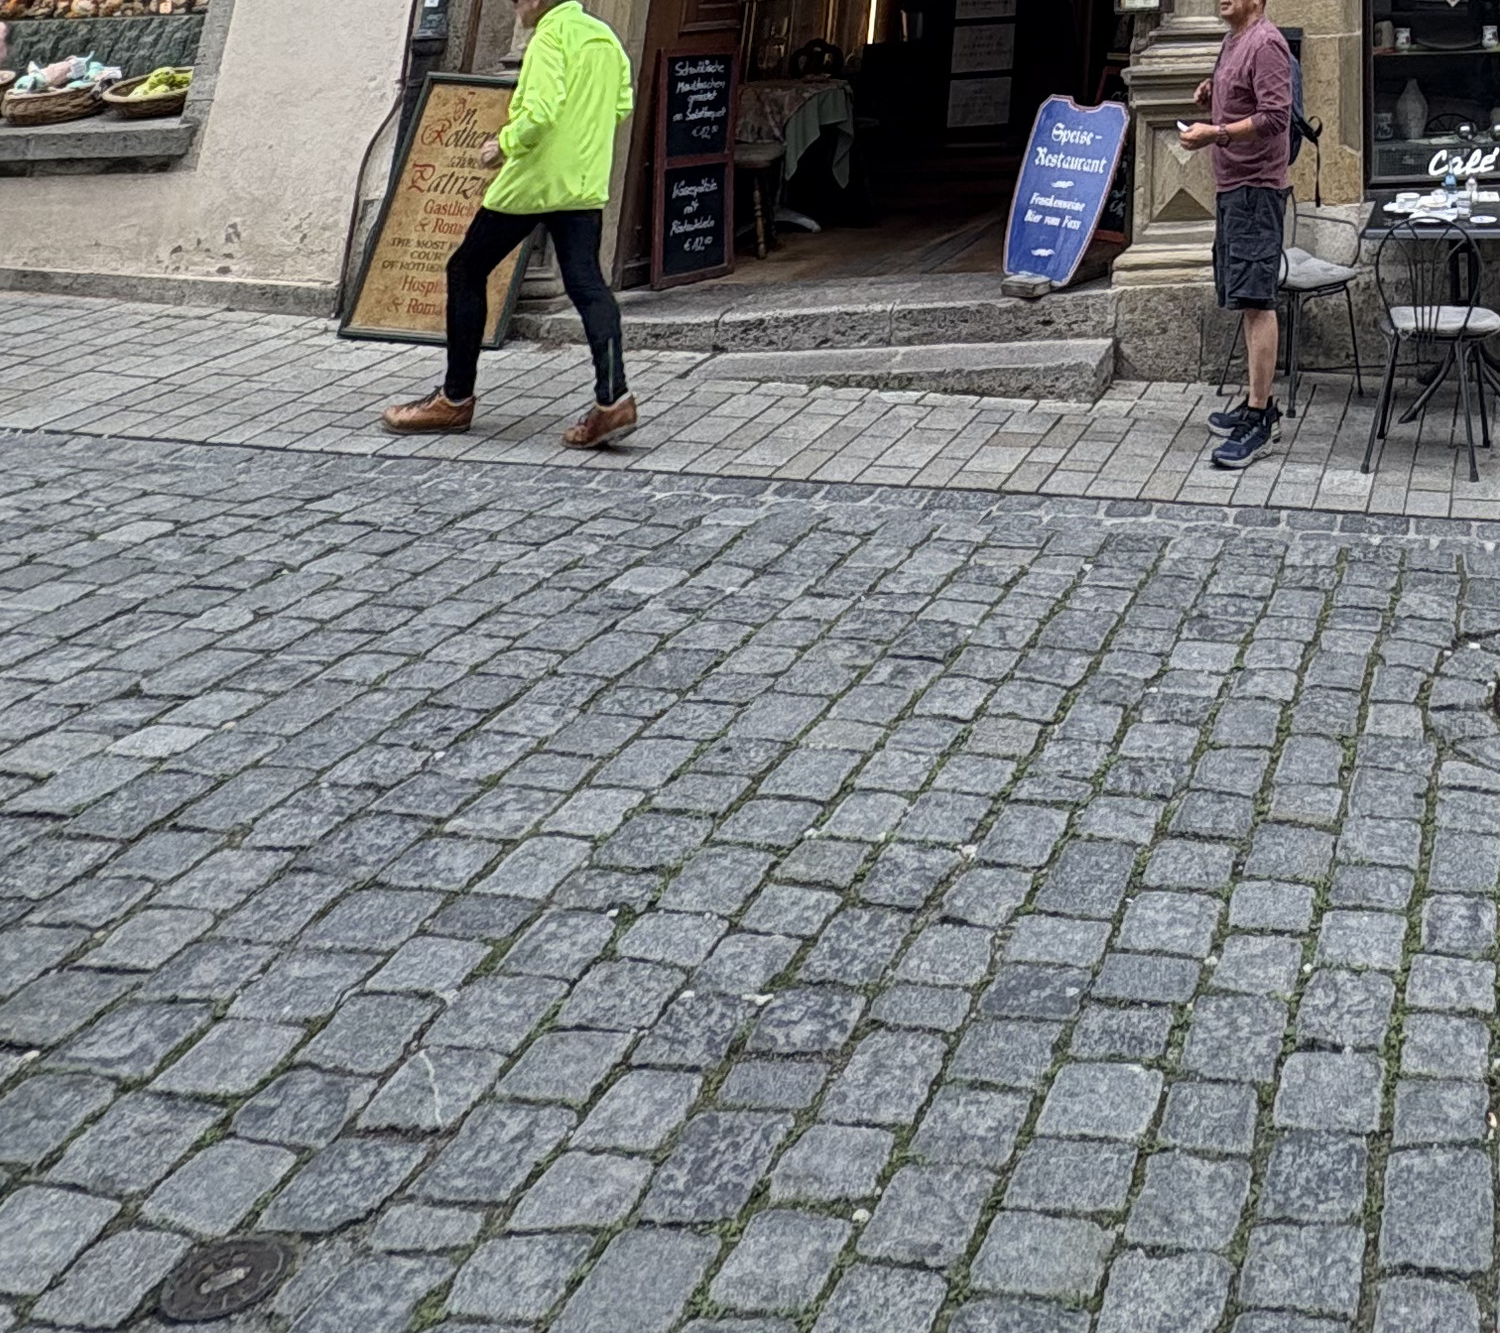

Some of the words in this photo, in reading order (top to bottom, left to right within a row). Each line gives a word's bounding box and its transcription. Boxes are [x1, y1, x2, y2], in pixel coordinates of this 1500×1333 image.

[1051, 122, 1104, 146] Speise-
[1034, 146, 1108, 174] Restaurant
[1428, 146, 1500, 176] Café
